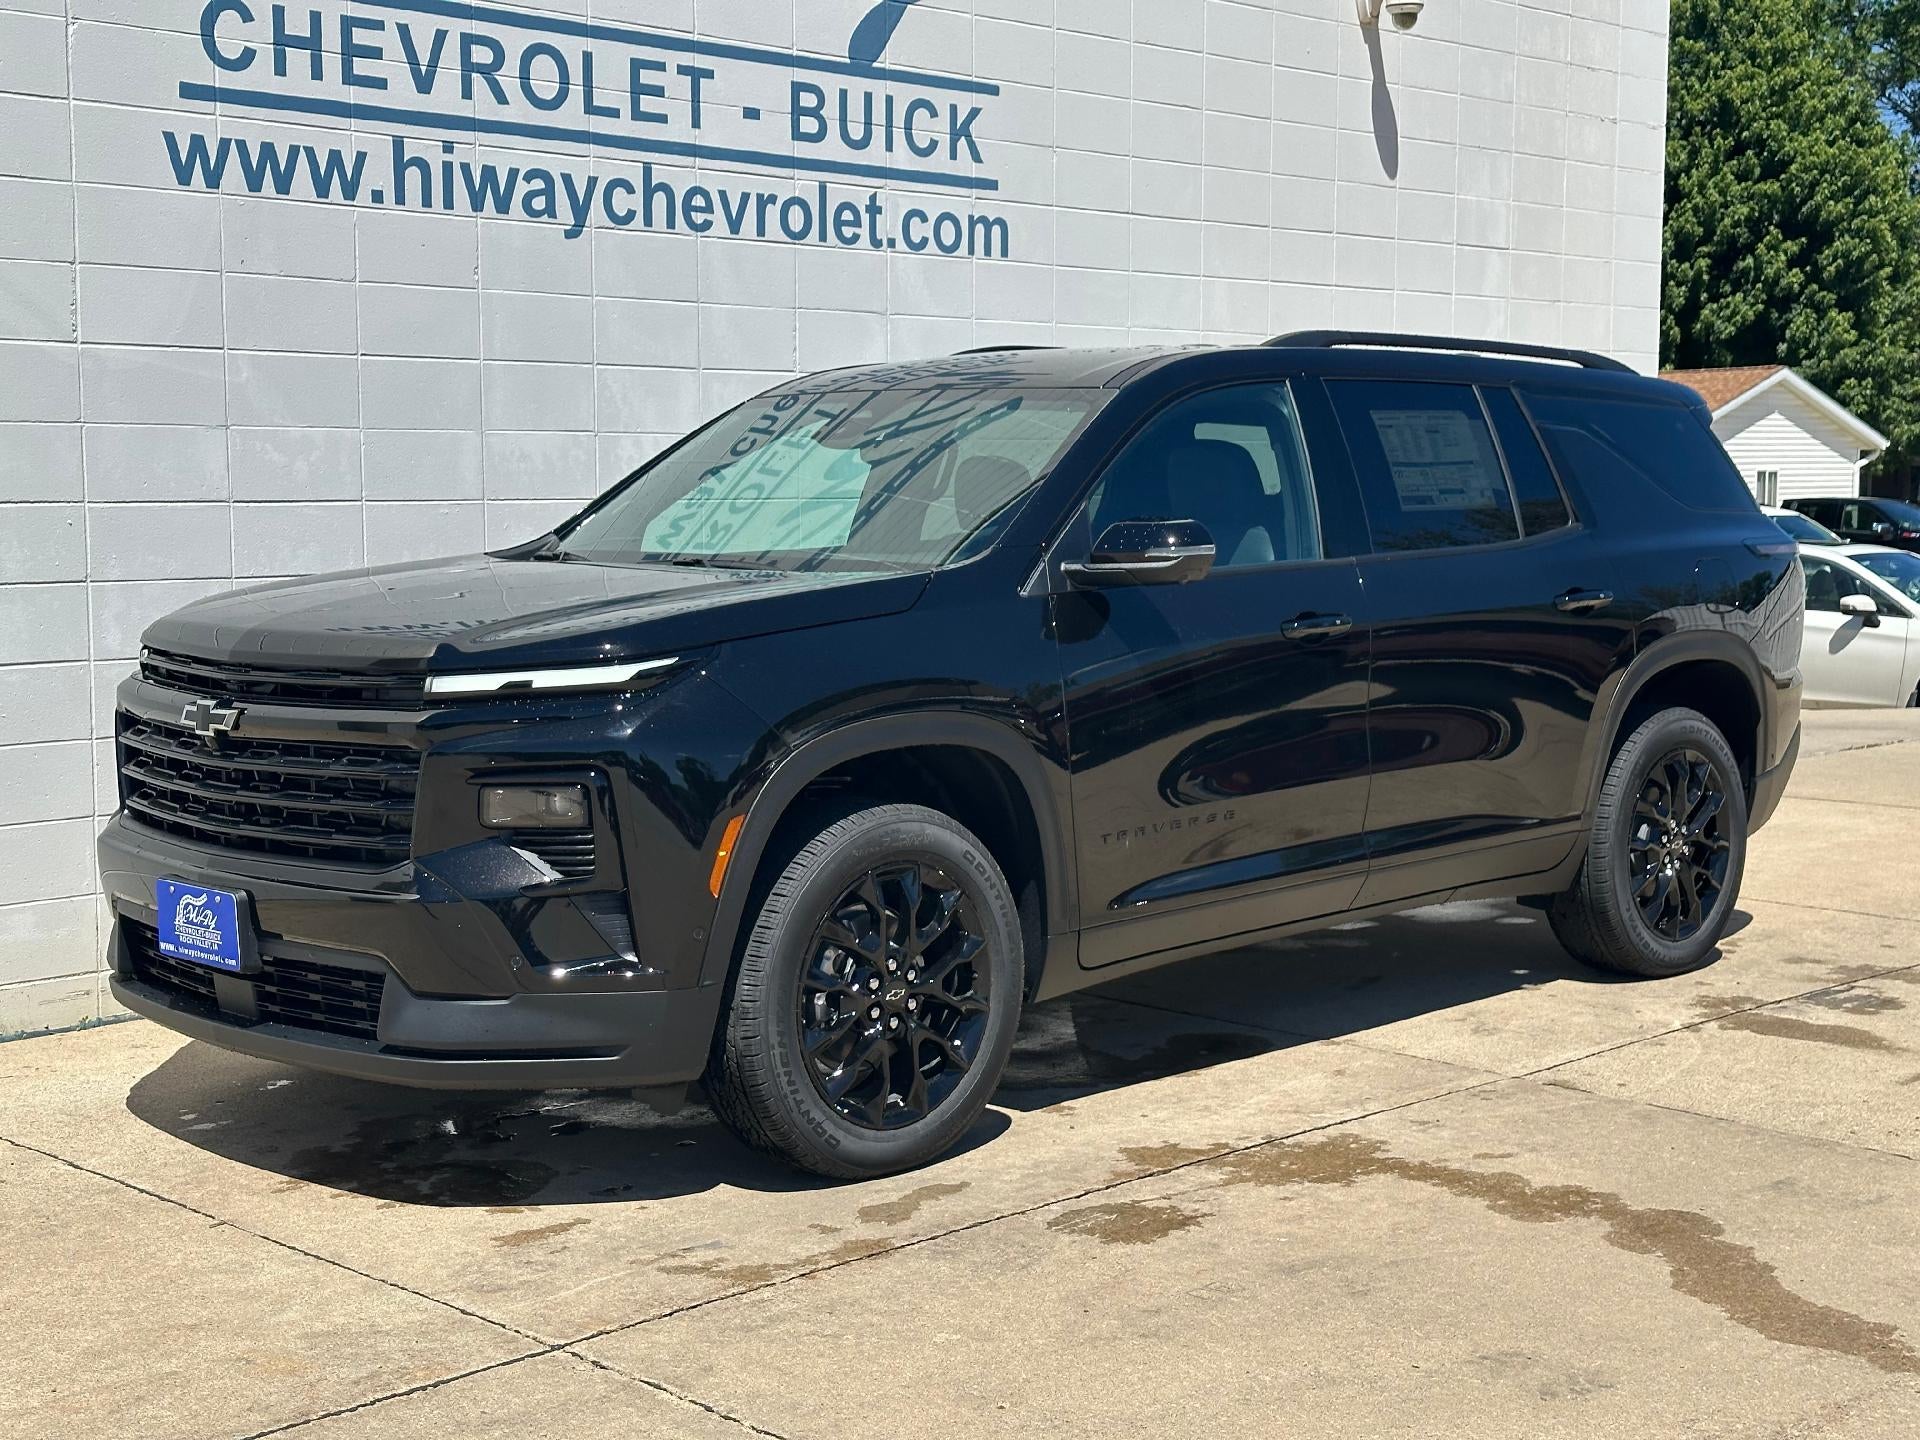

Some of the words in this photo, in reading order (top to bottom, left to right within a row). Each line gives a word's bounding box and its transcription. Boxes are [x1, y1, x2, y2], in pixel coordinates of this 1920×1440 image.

[199, 0, 714, 129] CHEVROLET
[790, 81, 984, 164] BUICK
[161, 130, 1009, 259] www.hiwaychevrolet.com
[1100, 809, 1236, 845] TRAVERSE
